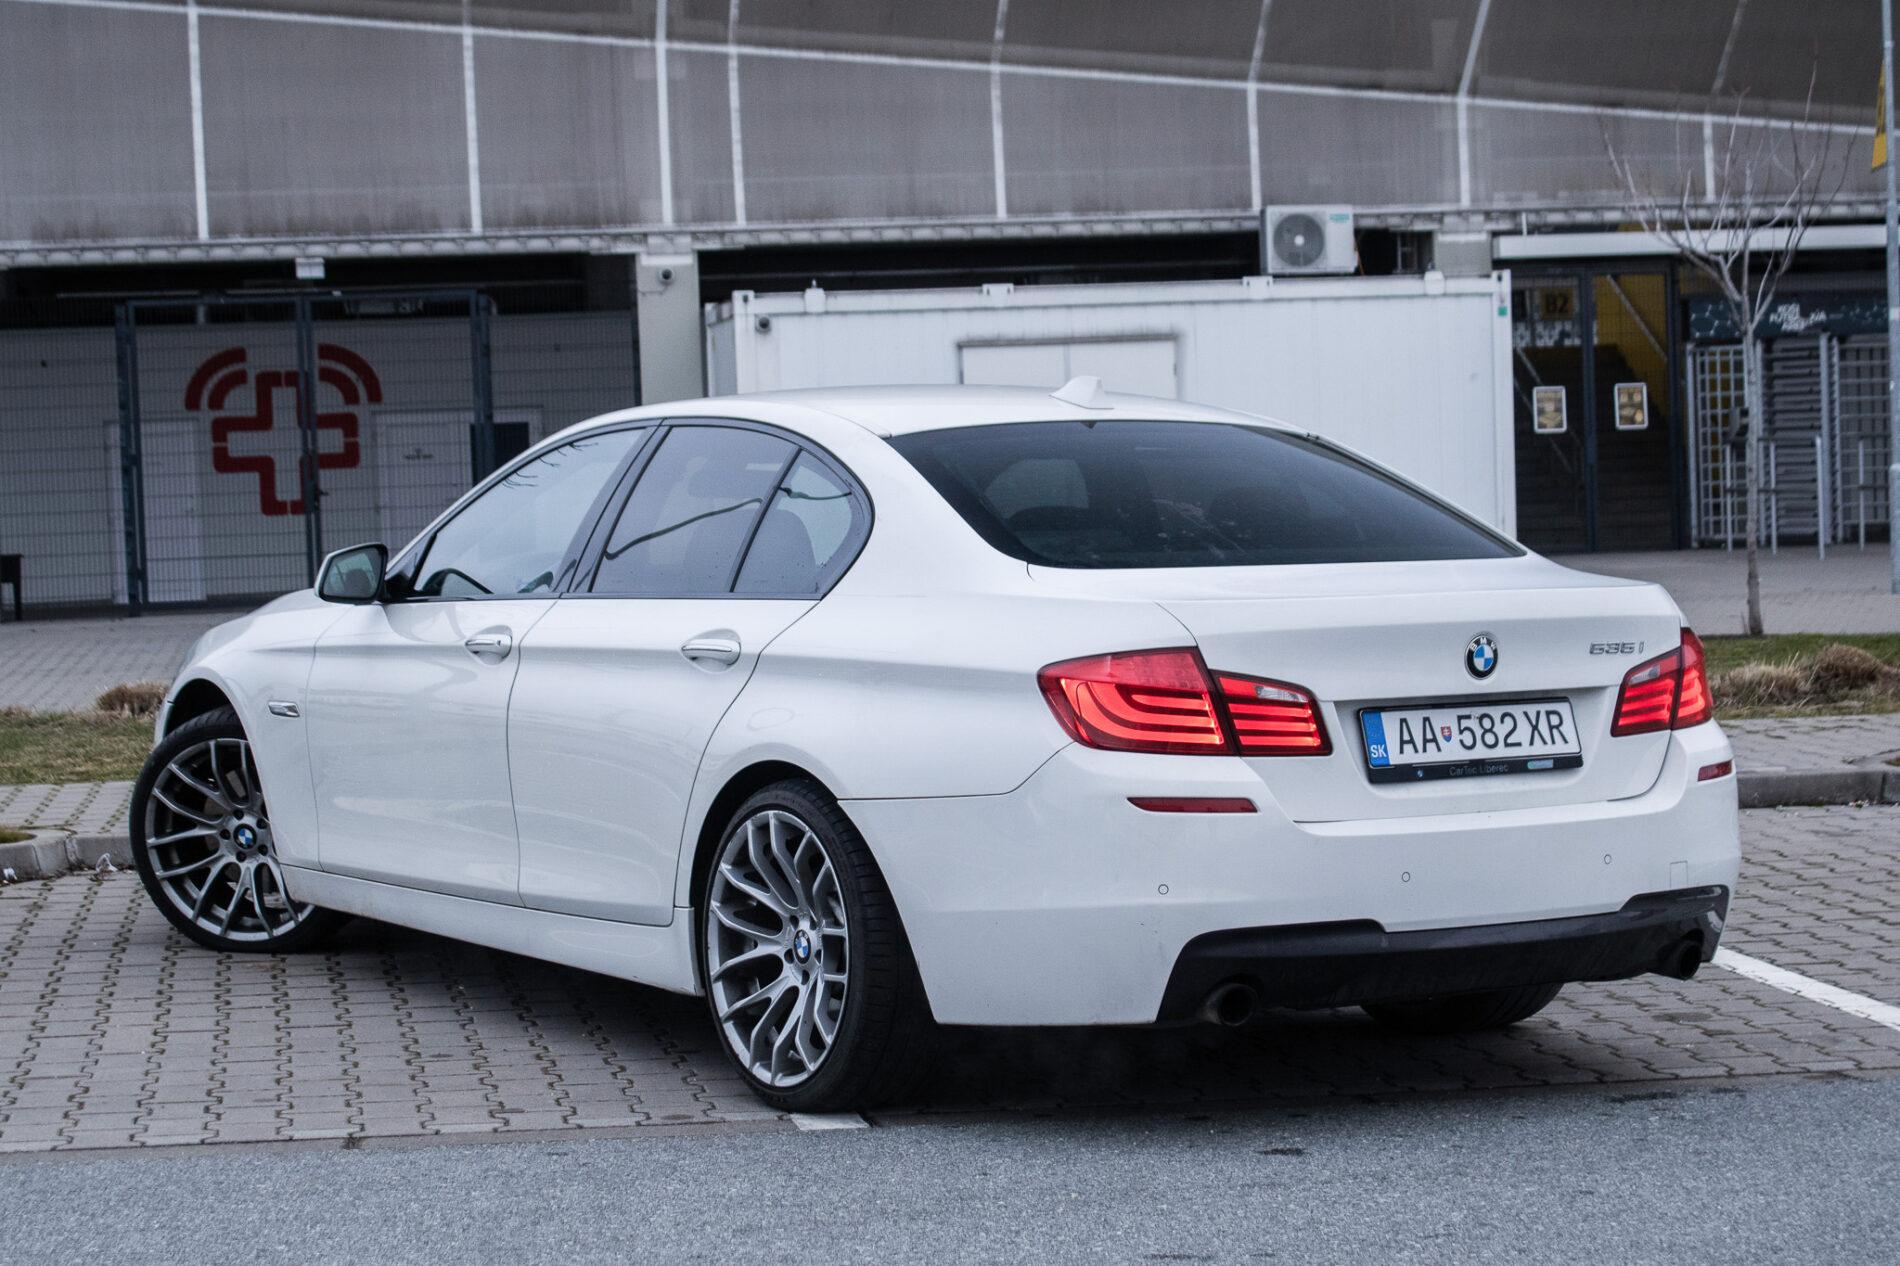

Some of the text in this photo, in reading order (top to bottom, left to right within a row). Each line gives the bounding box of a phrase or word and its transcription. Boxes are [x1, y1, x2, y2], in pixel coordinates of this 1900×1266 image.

[1399, 709, 1569, 755] AA 582XR
[1370, 744, 1387, 758] SK
